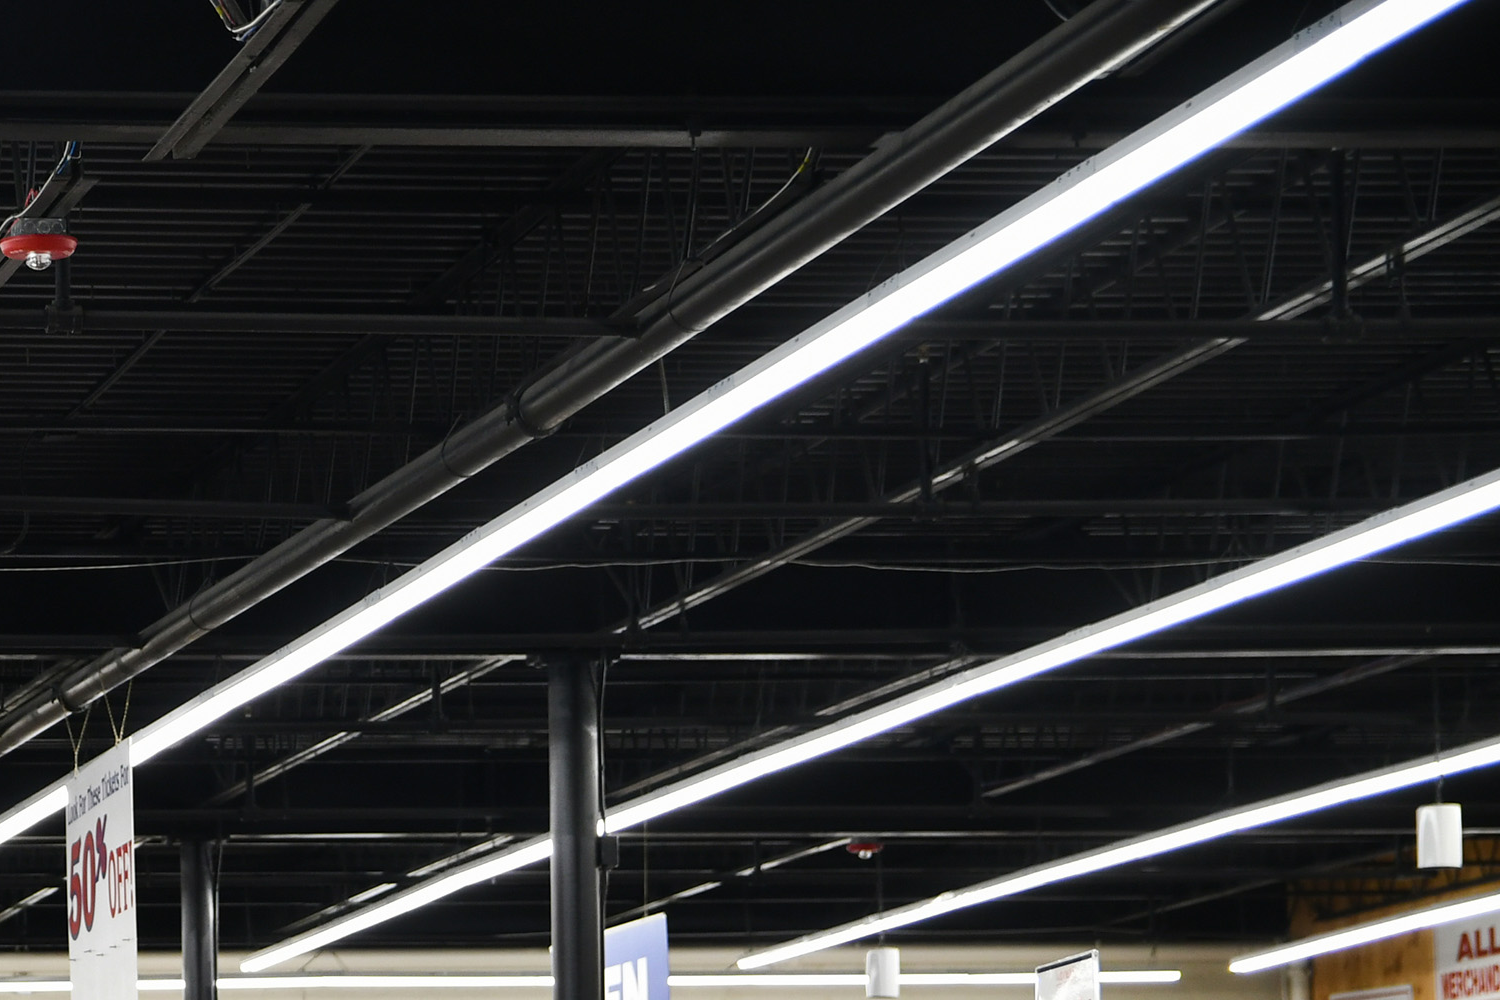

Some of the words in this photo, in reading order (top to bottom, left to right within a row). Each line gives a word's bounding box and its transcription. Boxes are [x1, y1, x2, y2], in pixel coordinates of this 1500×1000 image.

[87, 785, 100, 811] These
[102, 770, 119, 800] Tickets
[120, 764, 129, 788] For
[69, 814, 107, 941] 50%
[108, 840, 134, 918] OFF!
[1457, 926, 1500, 962] ALL
